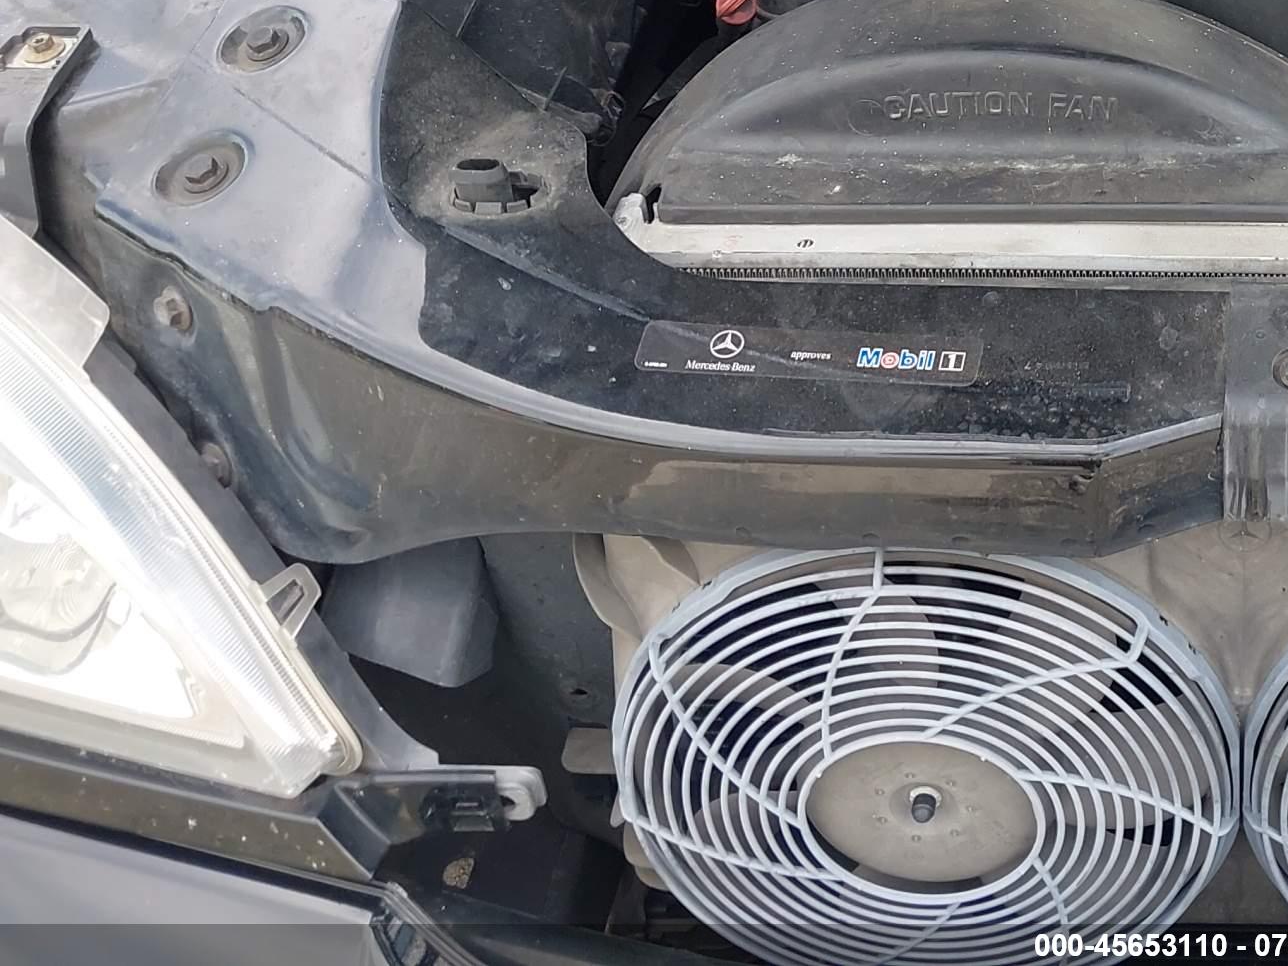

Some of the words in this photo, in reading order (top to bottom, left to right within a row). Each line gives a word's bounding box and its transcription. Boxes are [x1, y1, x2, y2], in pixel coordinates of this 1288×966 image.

[883, 90, 1033, 120] CAUTION
[1048, 92, 1119, 121] FAN
[789, 350, 832, 361] approves
[856, 347, 937, 371] Mobil
